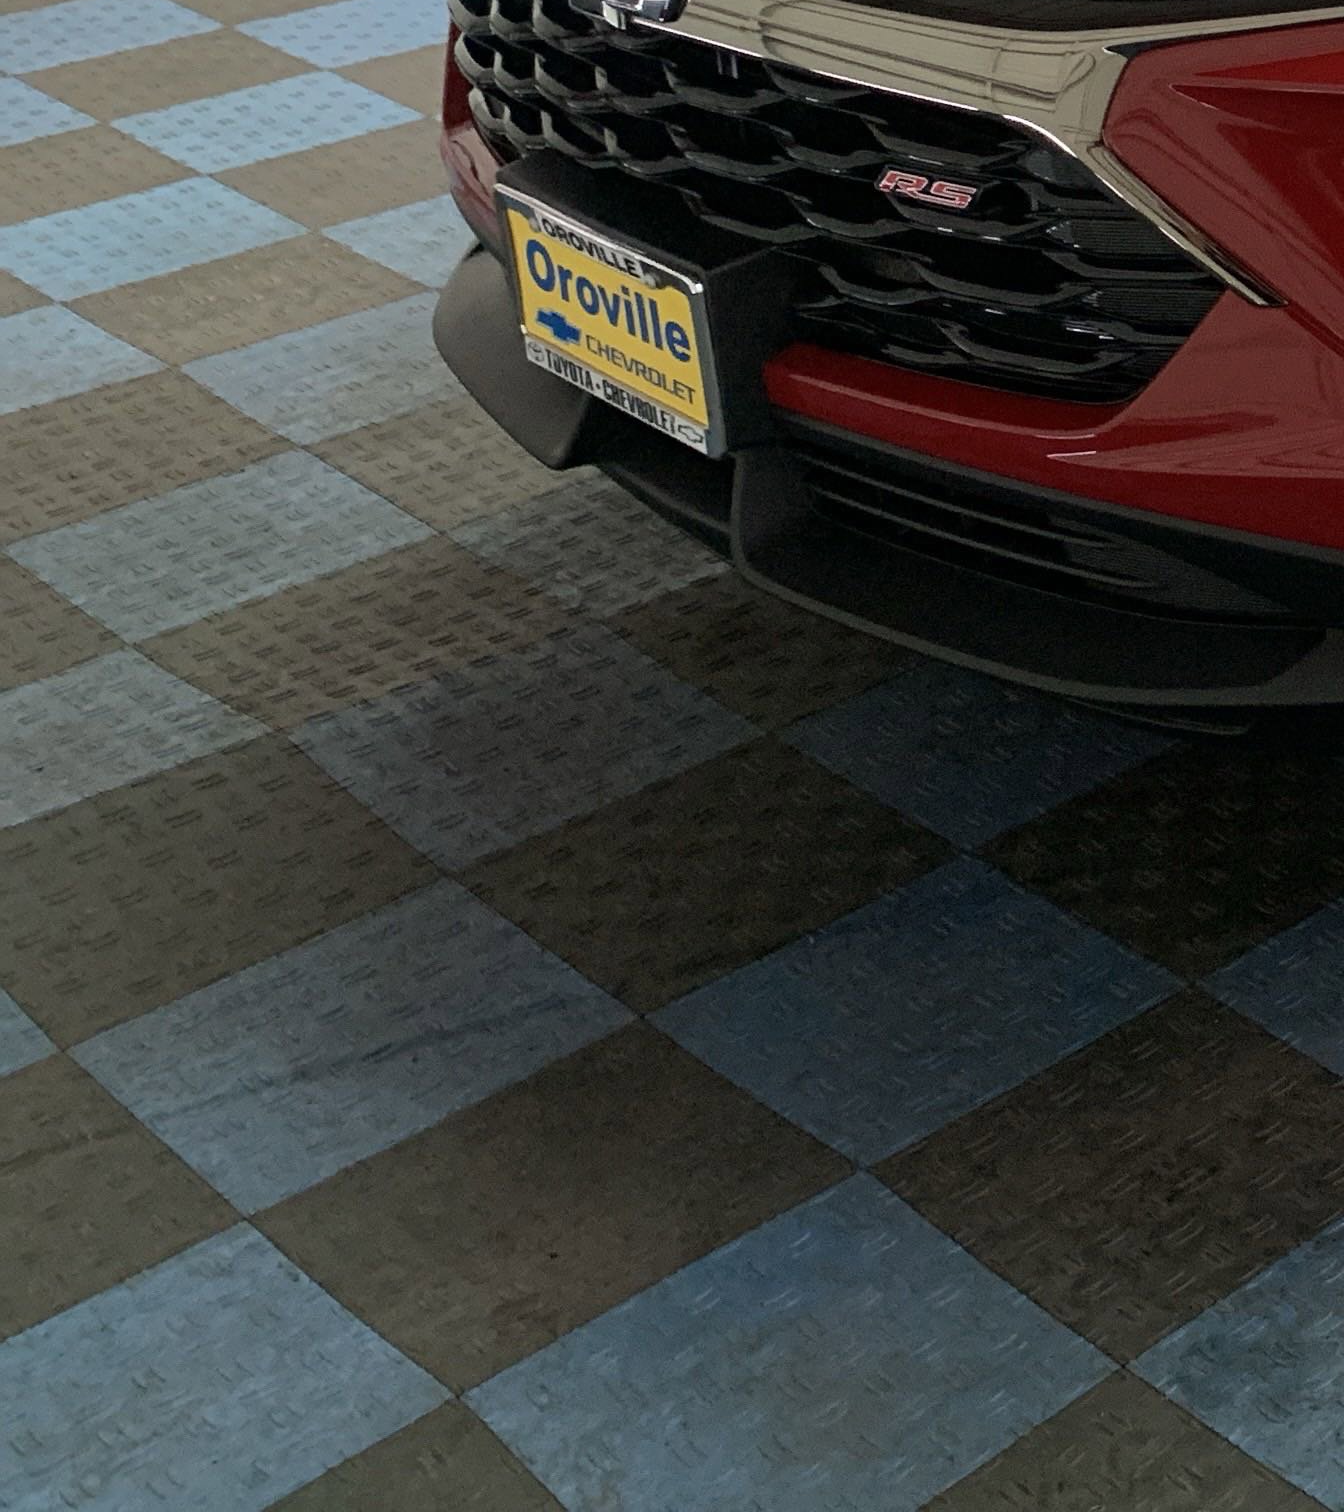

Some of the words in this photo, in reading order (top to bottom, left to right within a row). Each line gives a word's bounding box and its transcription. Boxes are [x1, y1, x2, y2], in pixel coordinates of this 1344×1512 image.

[879, 170, 977, 209] RS
[542, 218, 641, 278] OROVILLE
[525, 239, 691, 363] Oroville
[545, 350, 593, 390] TOYOTA
[602, 378, 676, 431] CHEVROLET
[586, 334, 696, 405] CHEVROLET
